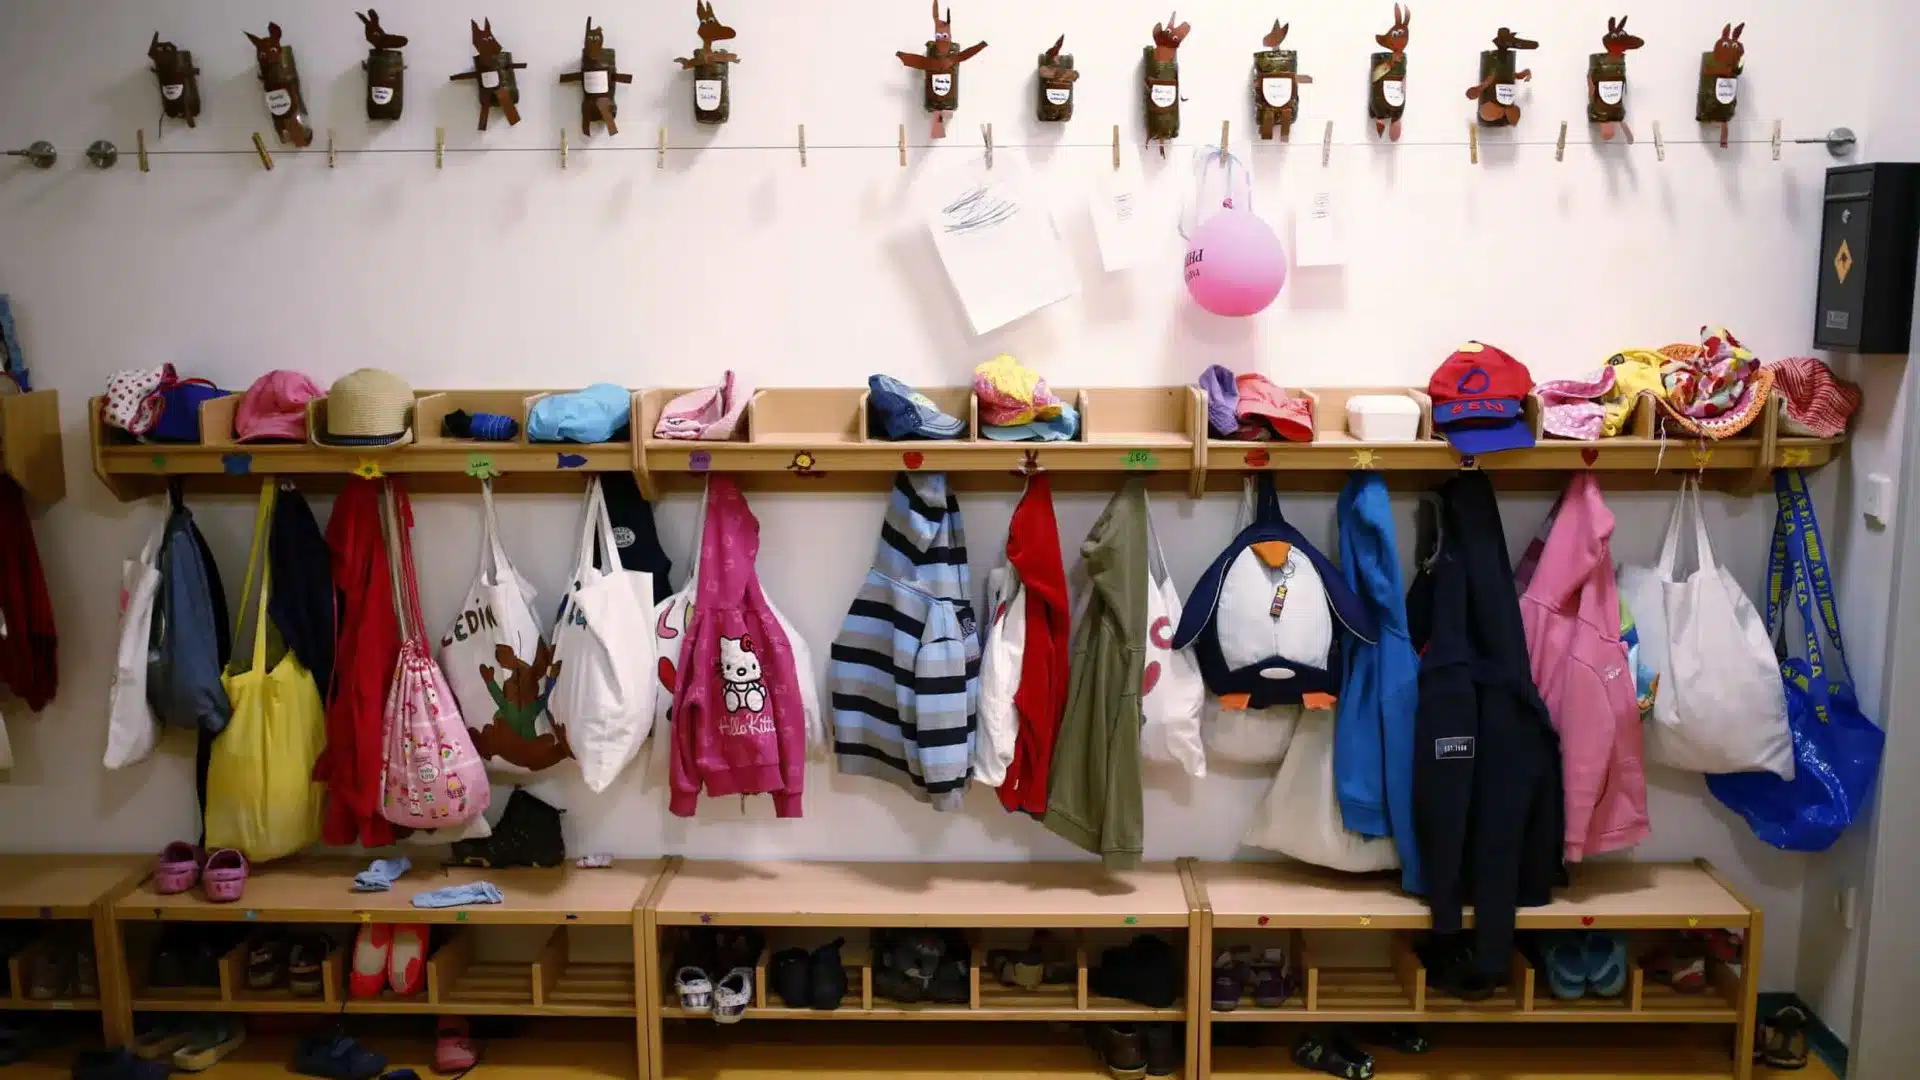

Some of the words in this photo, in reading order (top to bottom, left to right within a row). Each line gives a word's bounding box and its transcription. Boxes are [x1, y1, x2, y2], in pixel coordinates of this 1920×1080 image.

[1779, 490, 1796, 536] IKEA
[1793, 560, 1808, 606] IKEA
[1807, 631, 1823, 679] IKEA
